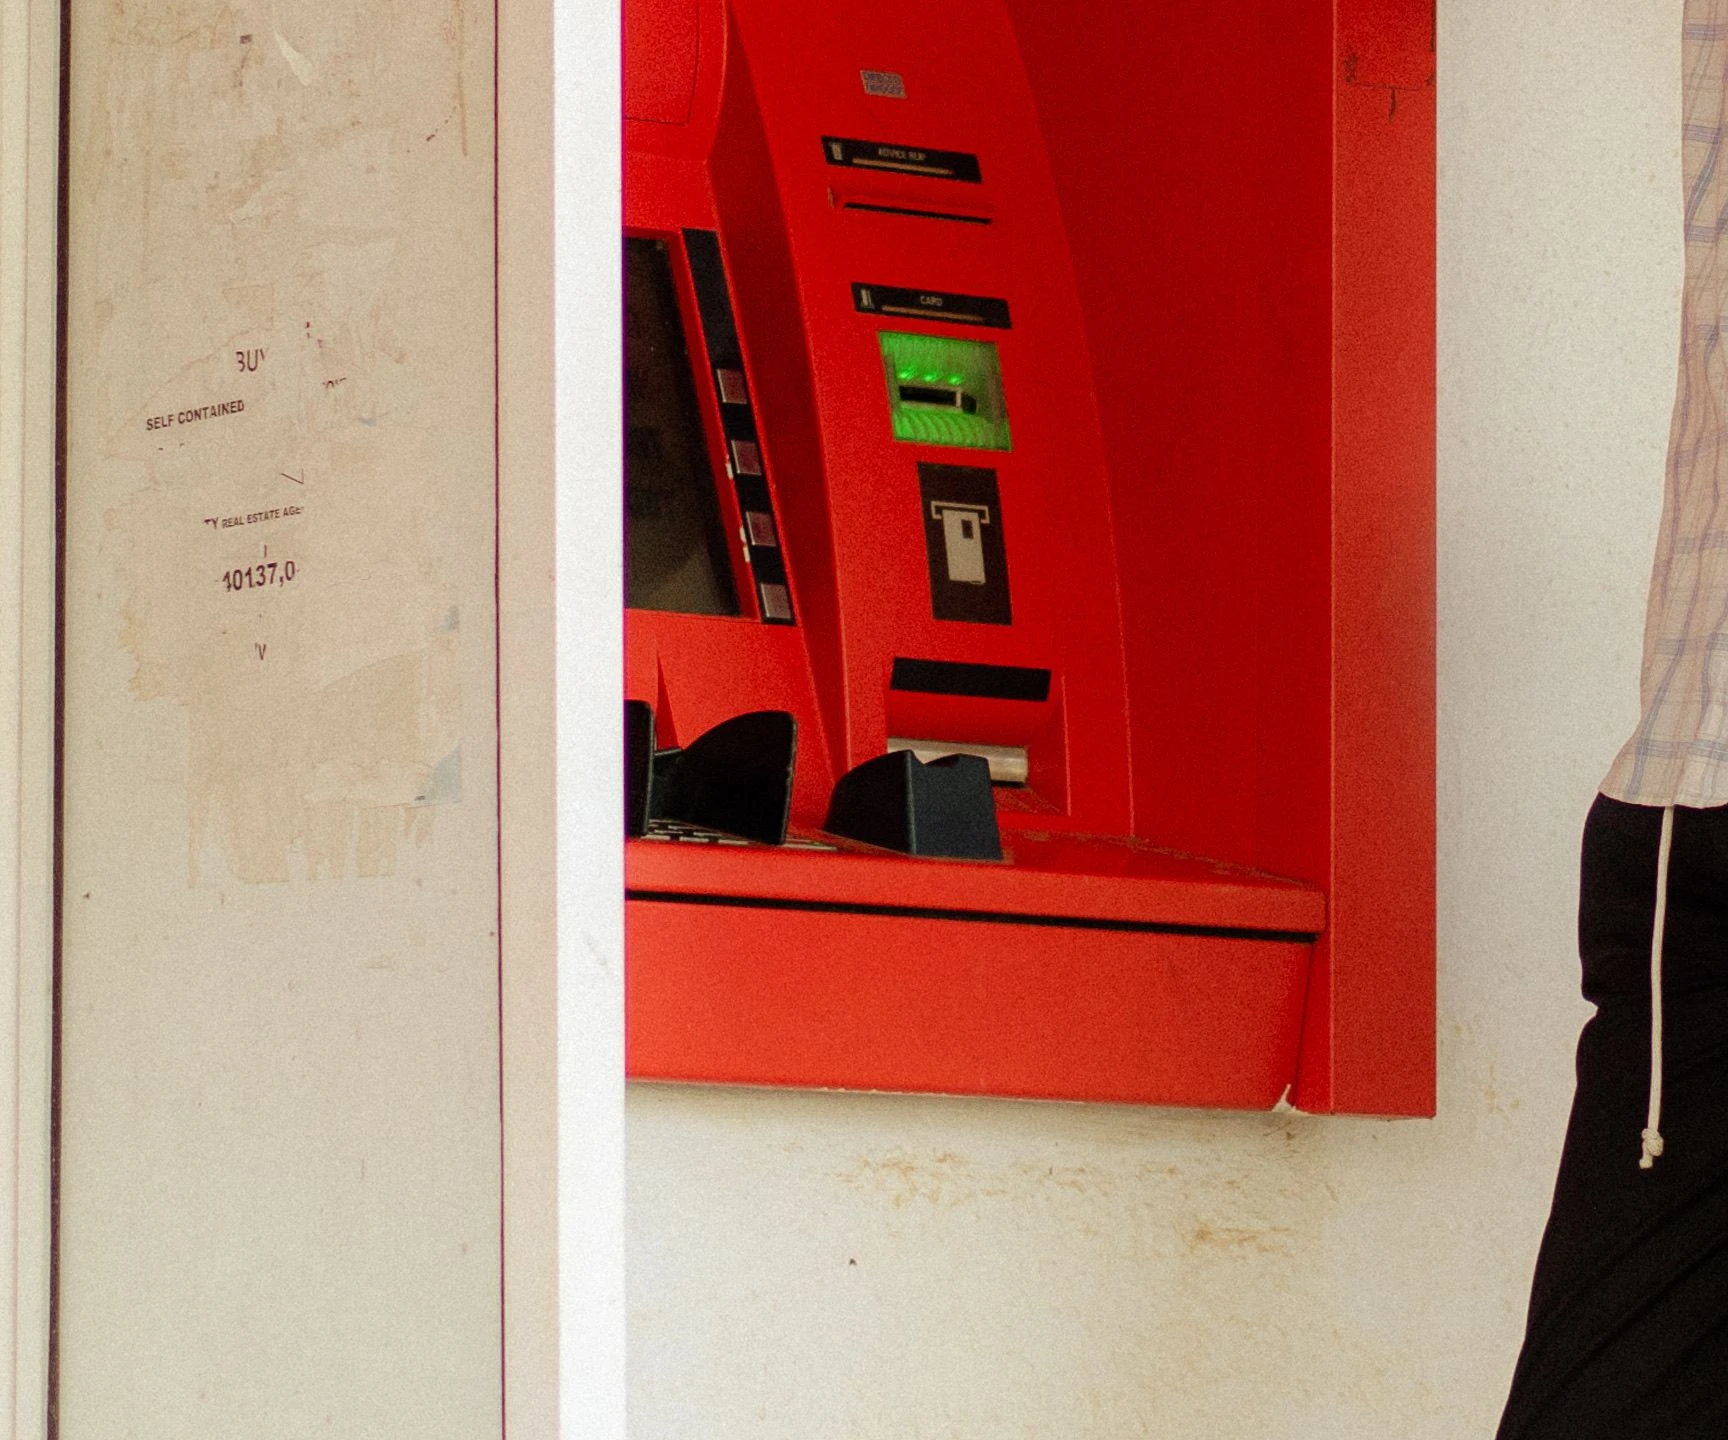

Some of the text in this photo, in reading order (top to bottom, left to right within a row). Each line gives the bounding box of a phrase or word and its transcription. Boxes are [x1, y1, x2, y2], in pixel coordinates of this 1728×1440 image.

[919, 295, 943, 307] CARD
[146, 399, 245, 431] SELF CONTAINED
[221, 516, 245, 529] REAL
[247, 509, 280, 524] ESTATE
